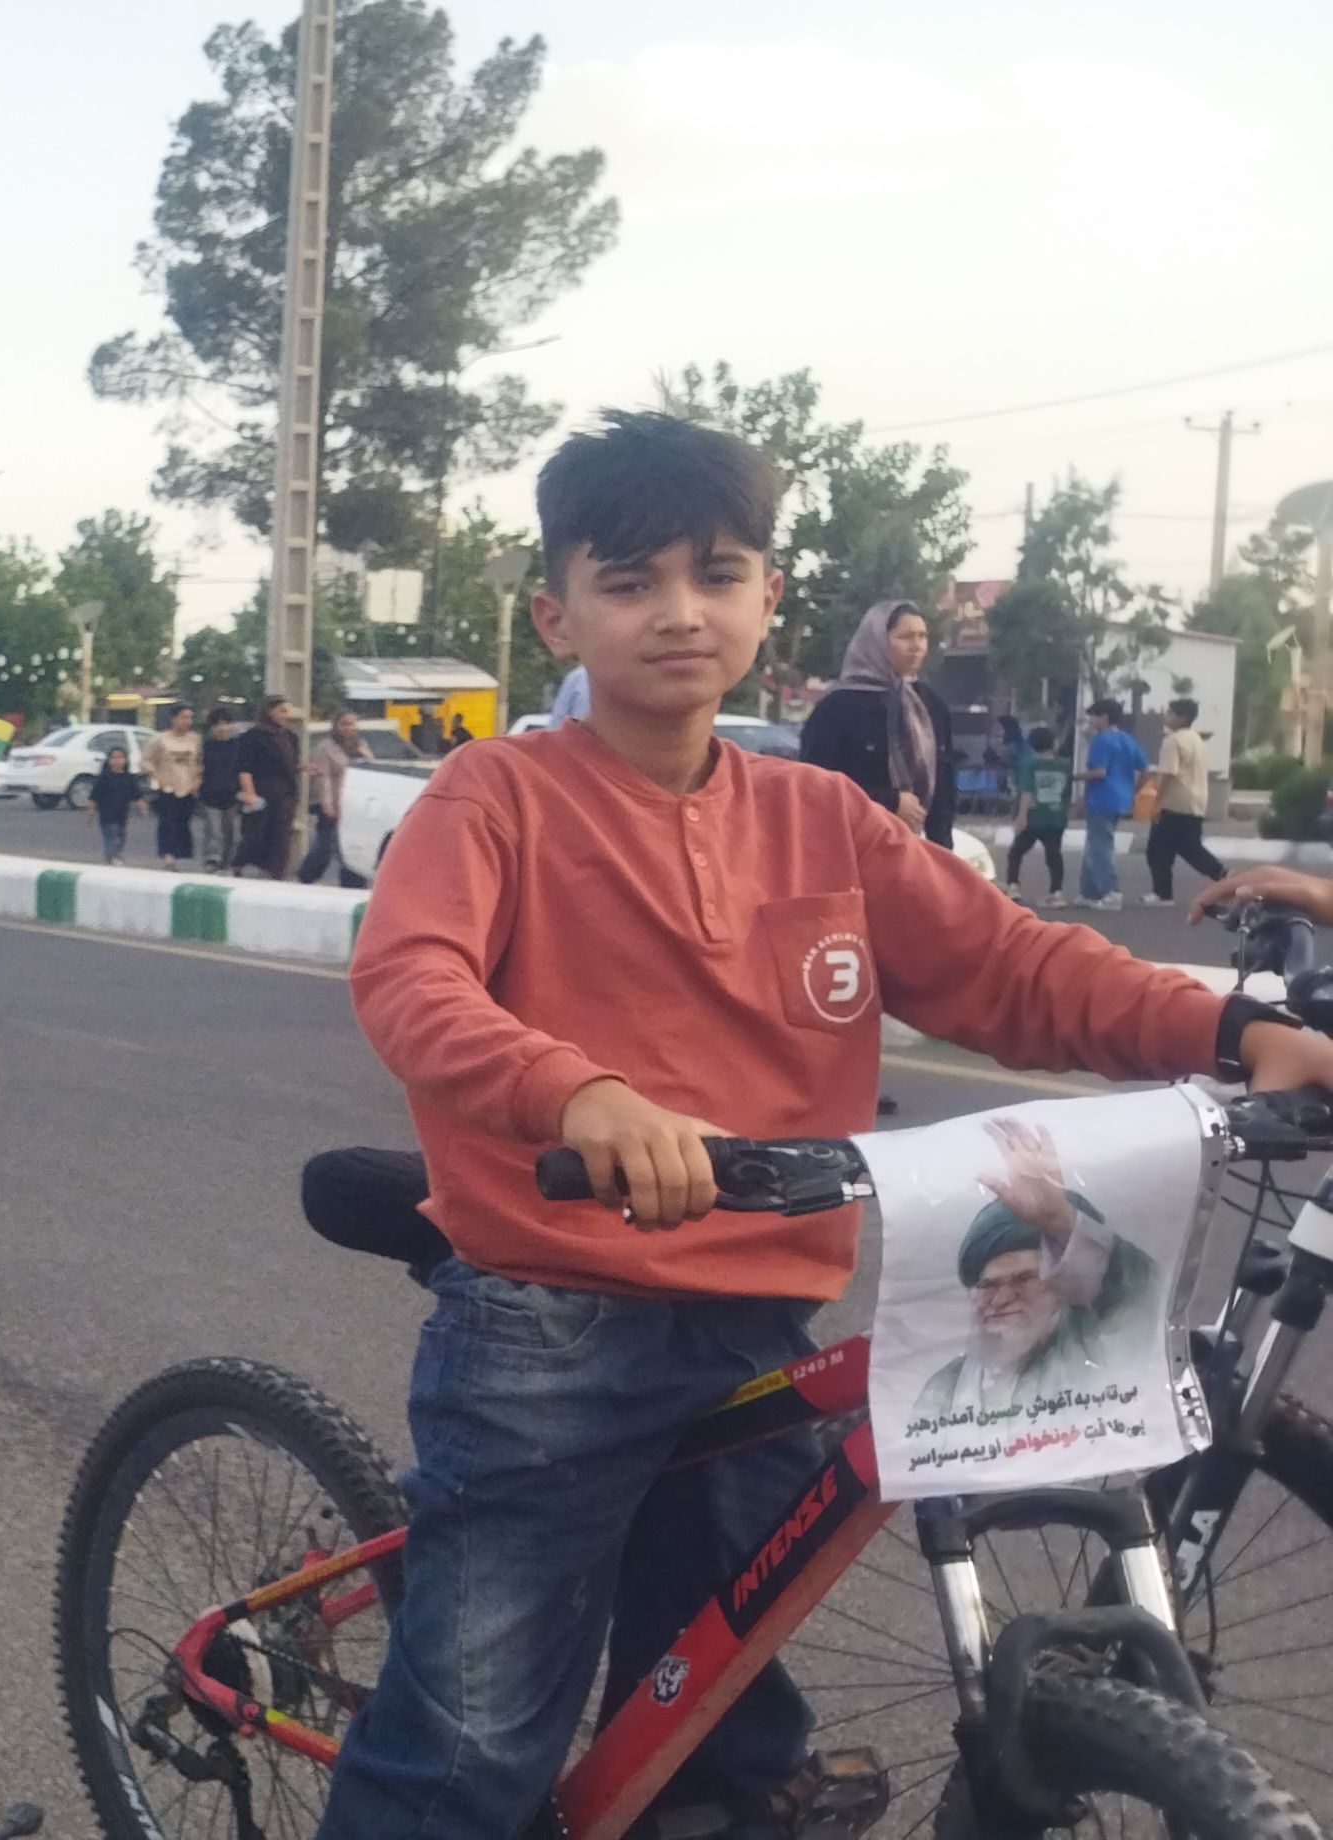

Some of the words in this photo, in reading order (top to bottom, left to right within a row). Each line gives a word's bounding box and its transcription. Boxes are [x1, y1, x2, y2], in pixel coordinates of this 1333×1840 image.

[825, 950, 860, 1002] 3
[977, 1403, 1023, 1427] حسین
[908, 1447, 959, 1472] سراسر
[733, 1463, 838, 1613] INTENSE
